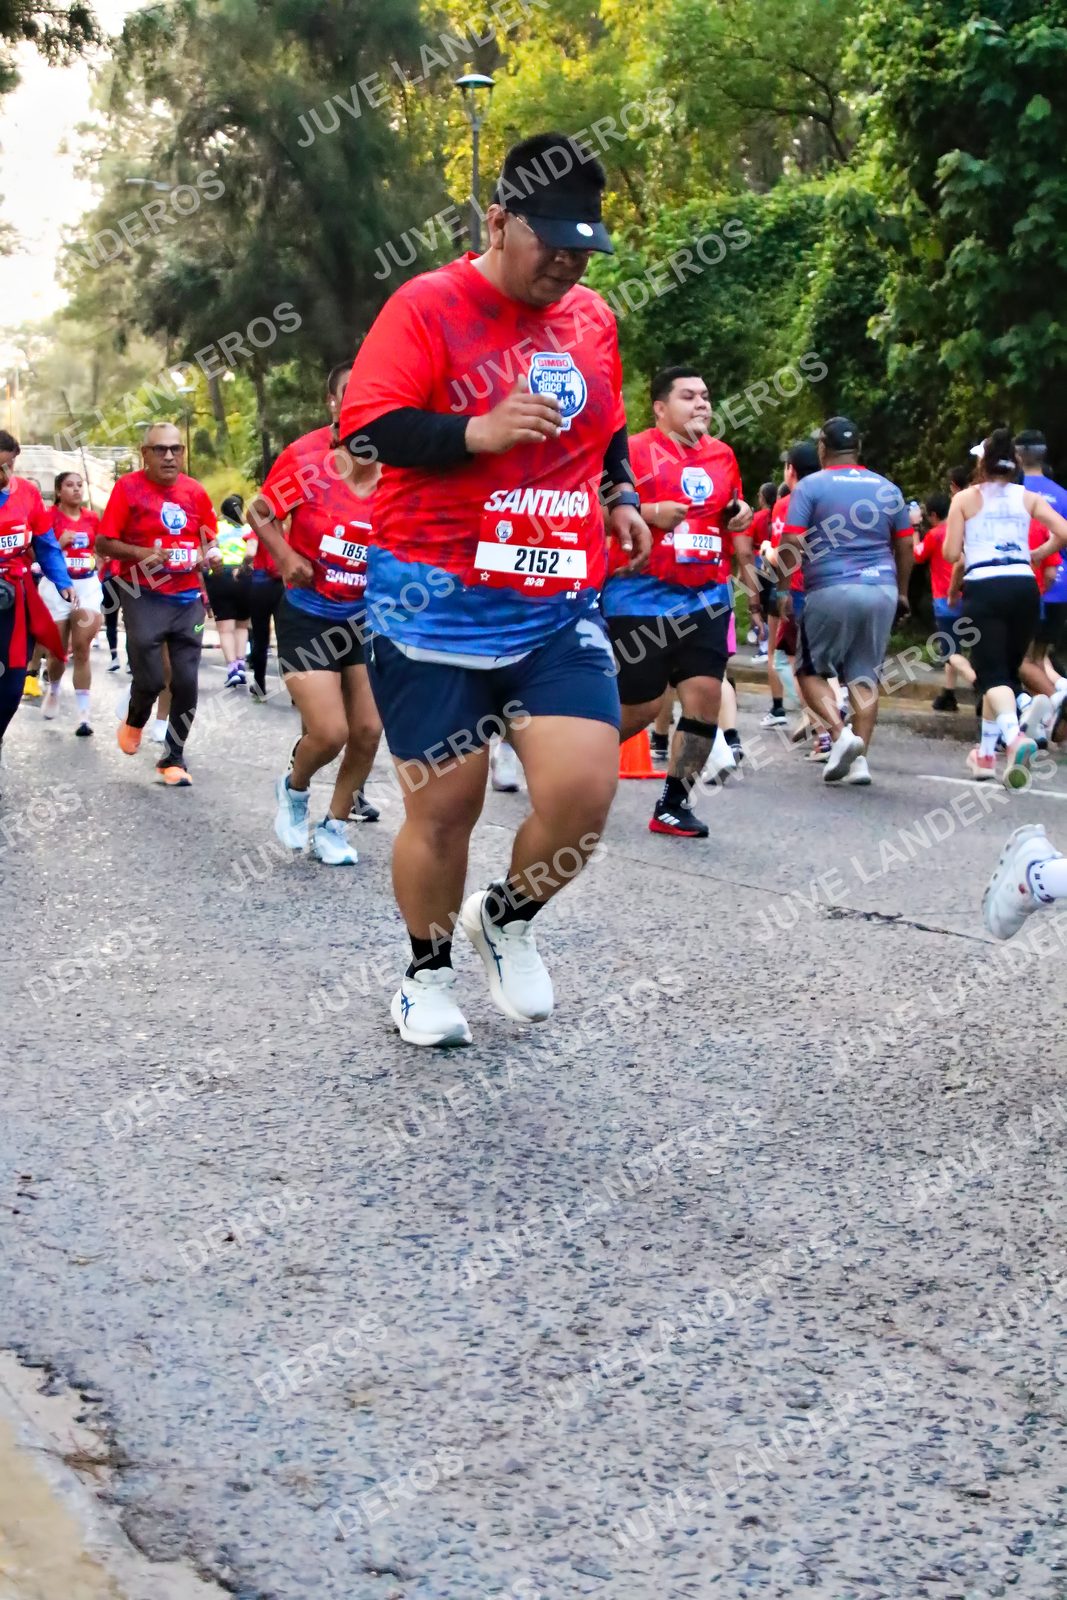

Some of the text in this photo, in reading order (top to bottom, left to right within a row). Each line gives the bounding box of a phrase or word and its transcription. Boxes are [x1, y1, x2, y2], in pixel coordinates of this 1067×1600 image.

[542, 370, 571, 383] Global
[538, 382, 562, 392] Race
[484, 488, 590, 517] SANTIAGO
[514, 548, 560, 575] 2152
